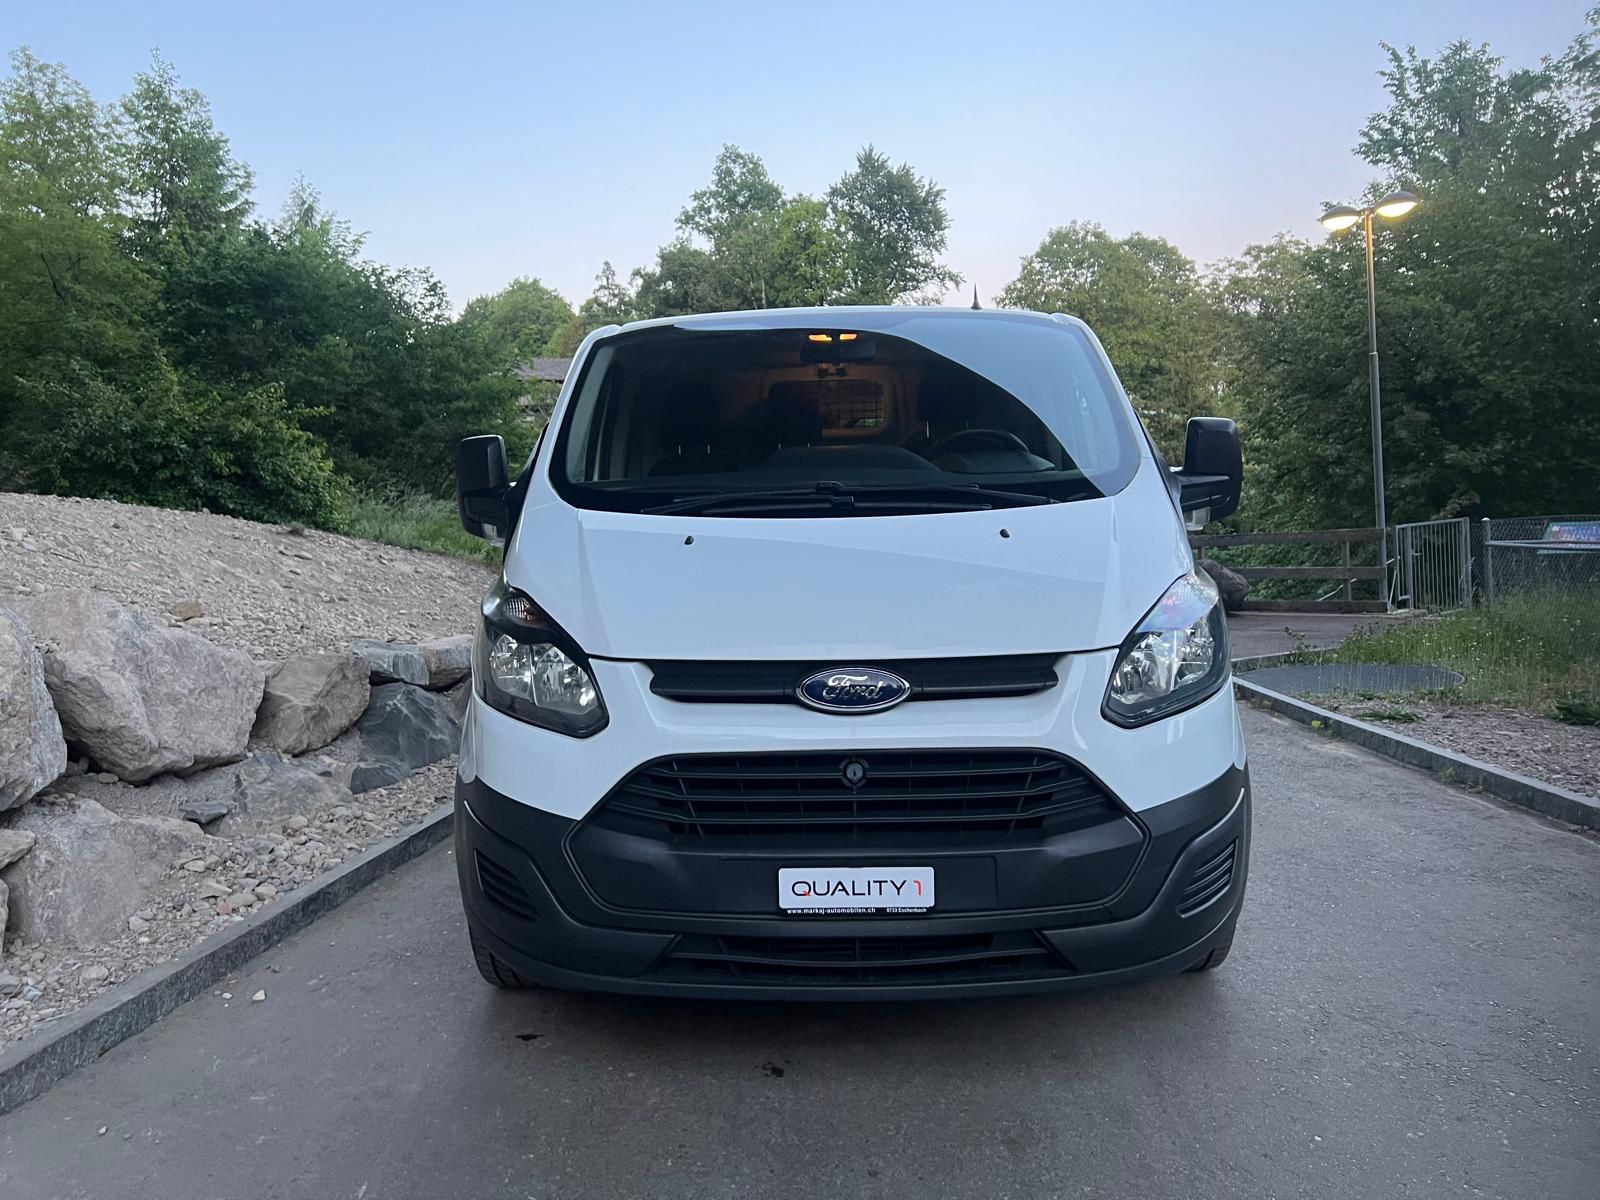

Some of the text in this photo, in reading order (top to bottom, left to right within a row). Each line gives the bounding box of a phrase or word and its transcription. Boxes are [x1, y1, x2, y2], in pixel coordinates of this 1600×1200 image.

[822, 674, 884, 700] Ford
[791, 880, 922, 896] QUALITY 1
